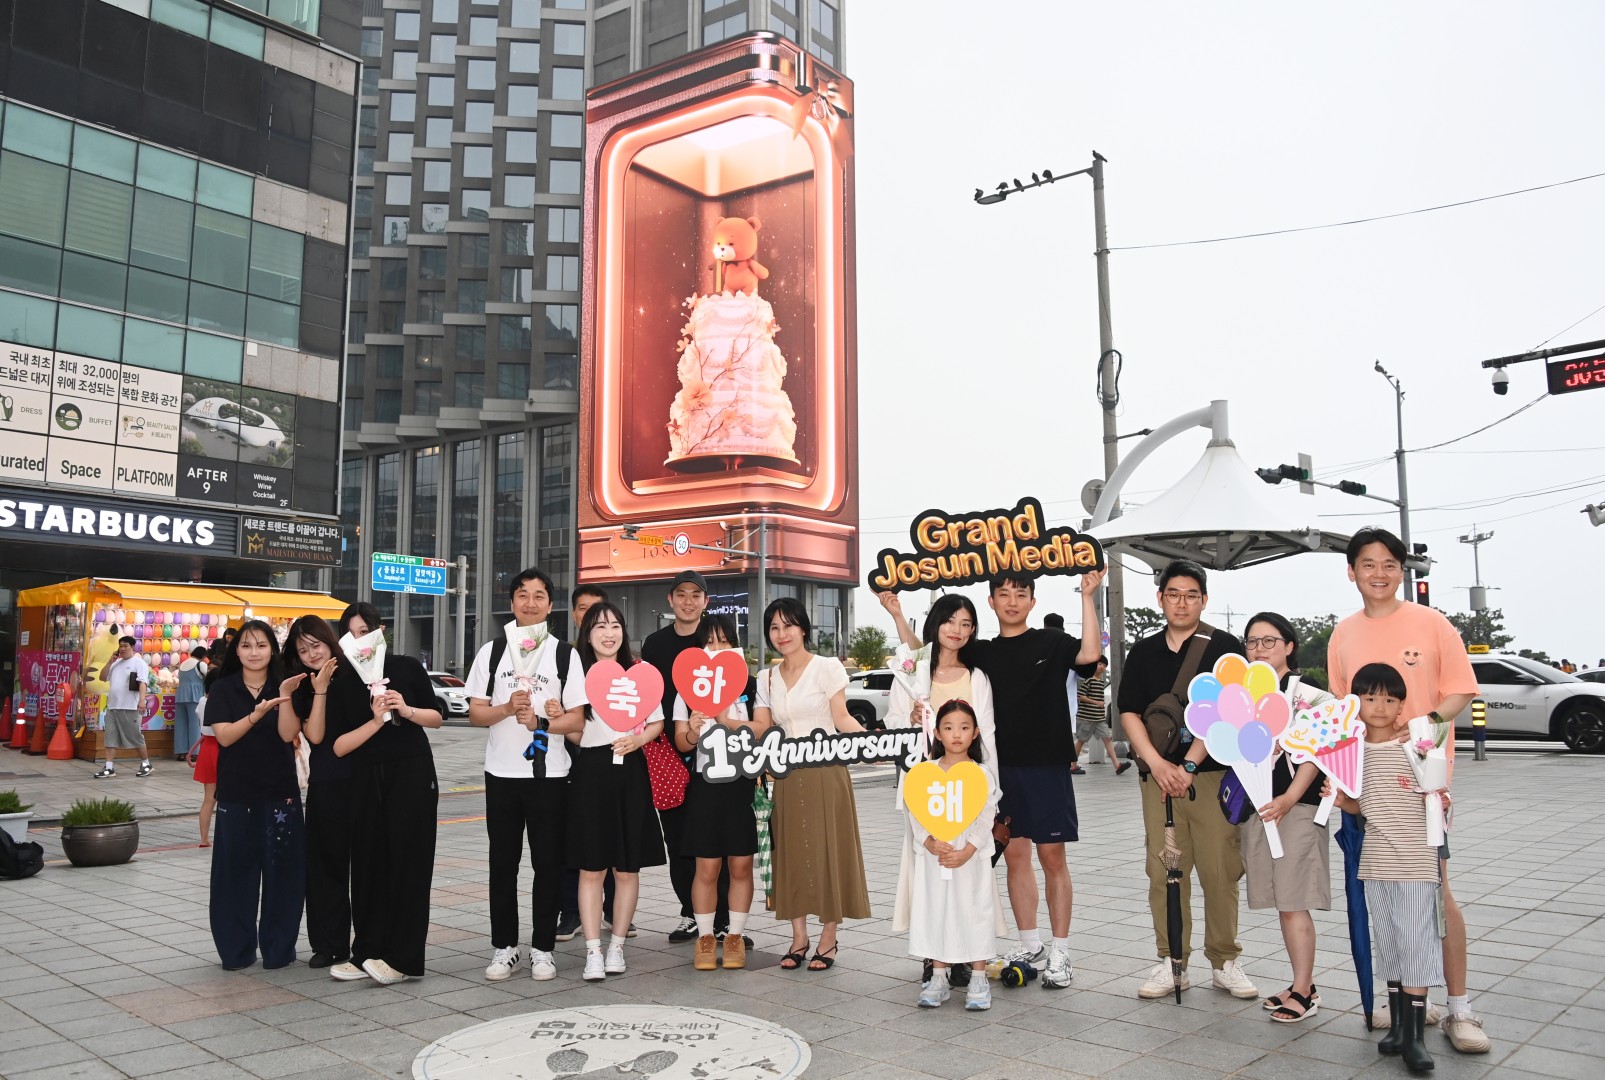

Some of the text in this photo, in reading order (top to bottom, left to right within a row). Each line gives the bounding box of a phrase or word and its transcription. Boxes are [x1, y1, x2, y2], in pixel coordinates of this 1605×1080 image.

[9, 351, 140, 385] 국내 최초 최대 32,000 평의
[31, 372, 50, 386] 대지
[57, 376, 76, 390] 위에
[78, 380, 115, 396] 조성되는
[121, 387, 139, 401] 복합
[141, 391, 159, 404] 문화
[161, 394, 178, 407] 공간
[20, 406, 43, 415] DRESS
[89, 416, 112, 426] BUFFET
[146, 421, 178, 431] BEAUTY SALON
[0, 455, 174, 487] urated Space PLATFORM
[187, 467, 228, 483] AFTER
[253, 473, 277, 483] Whiskey
[202, 482, 211, 494] 9
[253, 491, 276, 500] Cocktail
[280, 499, 288, 507] 2F
[0, 500, 215, 546] STARBUCKS
[244, 518, 266, 531] 새로운
[296, 524, 317, 536] 이끌어
[318, 527, 340, 539] 갑니다.
[916, 504, 1039, 553] Grand
[678, 540, 687, 550] 50
[874, 533, 1097, 589] Josun Media
[692, 665, 726, 704] 하
[606, 677, 641, 718] 축
[1487, 702, 1514, 710] NEMO
[703, 728, 924, 779] 1st Anniversary
[927, 780, 963, 823] 해
[530, 1030, 718, 1043] Photo Spot
